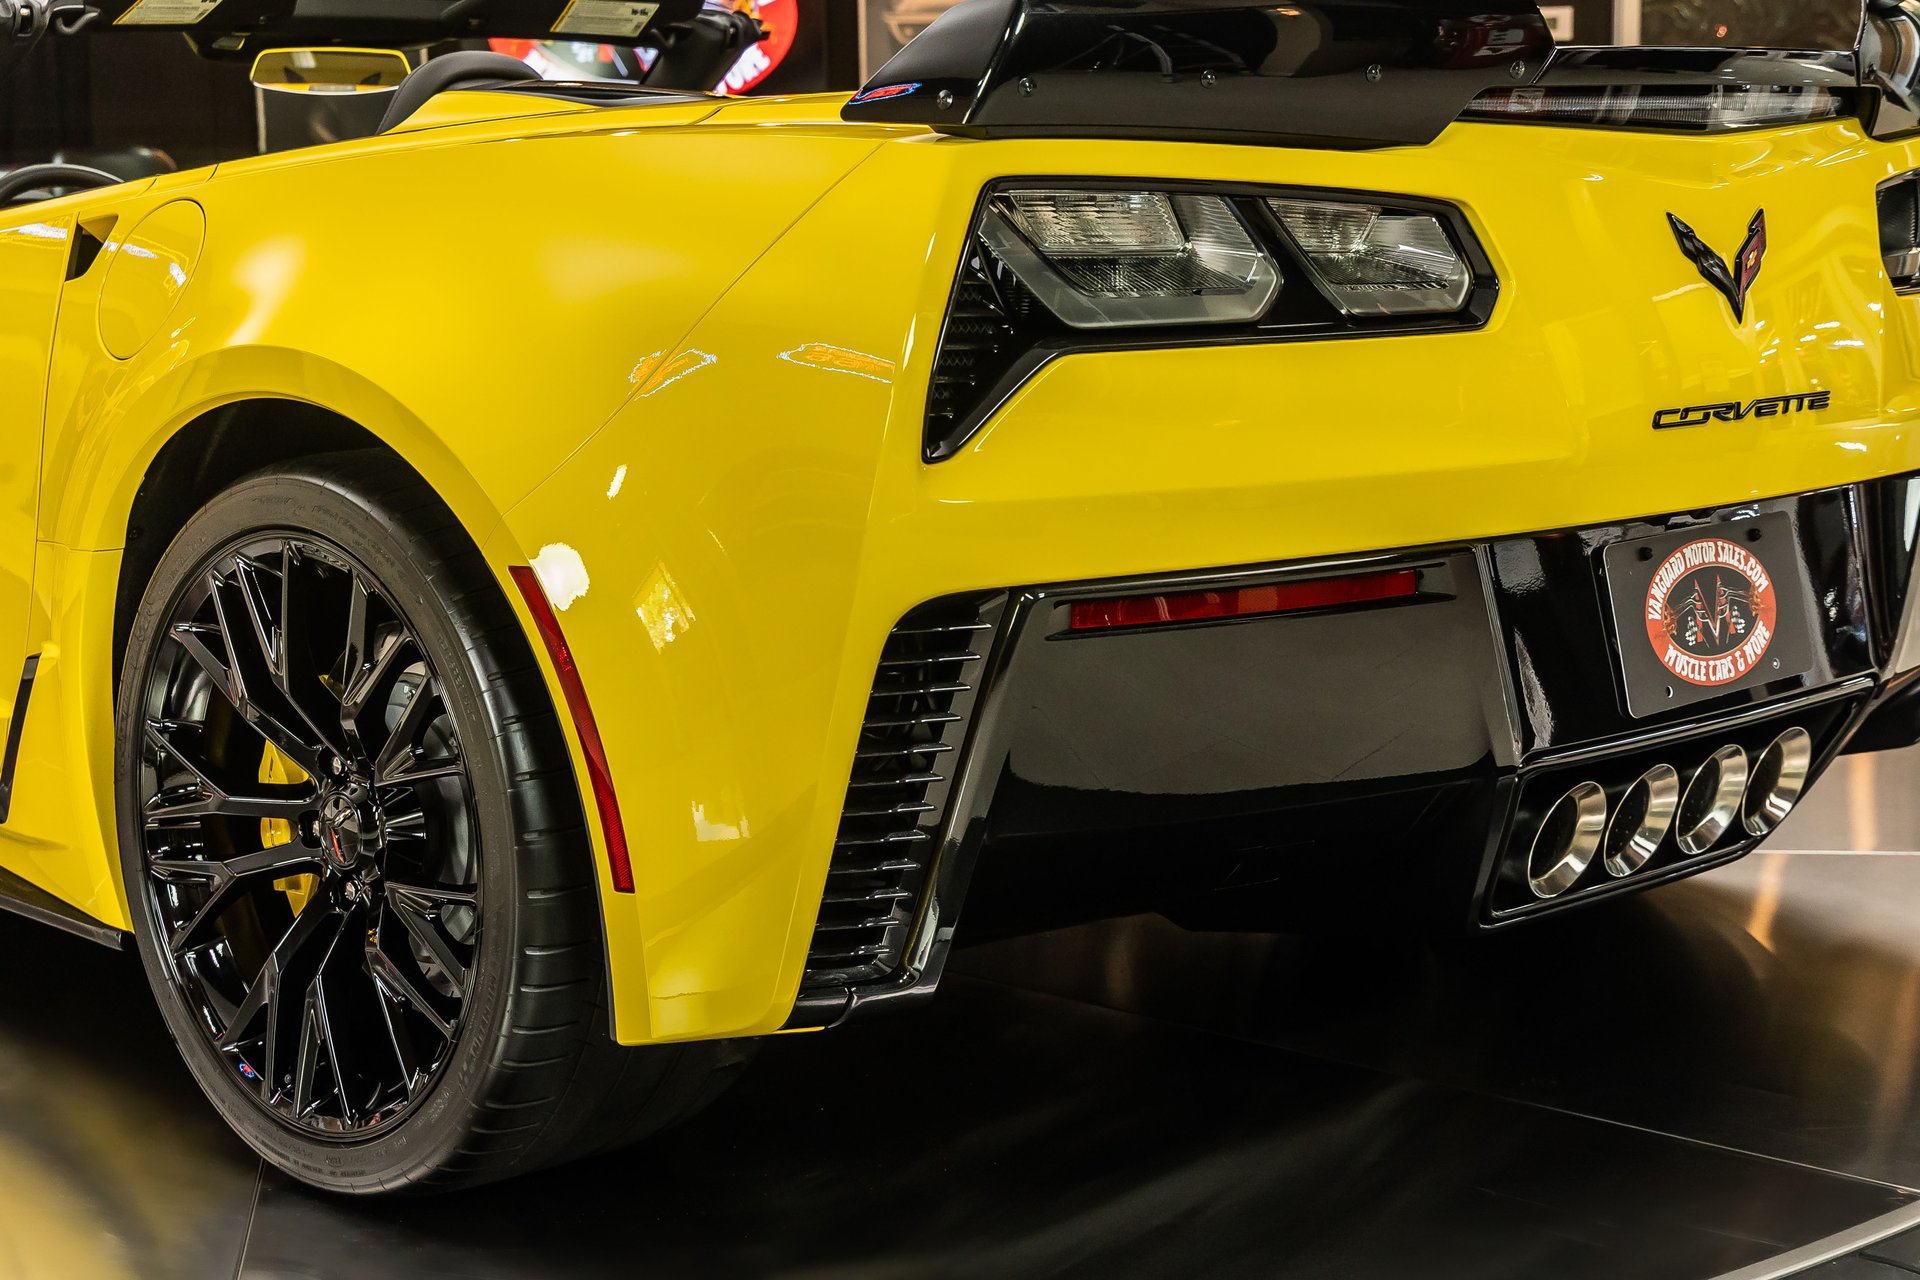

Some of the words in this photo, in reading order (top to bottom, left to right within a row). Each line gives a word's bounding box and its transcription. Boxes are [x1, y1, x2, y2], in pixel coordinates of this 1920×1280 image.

[1652, 390, 1831, 430] CORVETTE
[1648, 548, 1685, 621] VANGUARD
[1683, 541, 1716, 567] MOTOR
[1717, 541, 1769, 592] SALES.COM
[1664, 644, 1707, 682] MUSCLE
[1709, 655, 1736, 681] CARS
[1736, 654, 1746, 672] &
[1742, 620, 1770, 665] MORE
